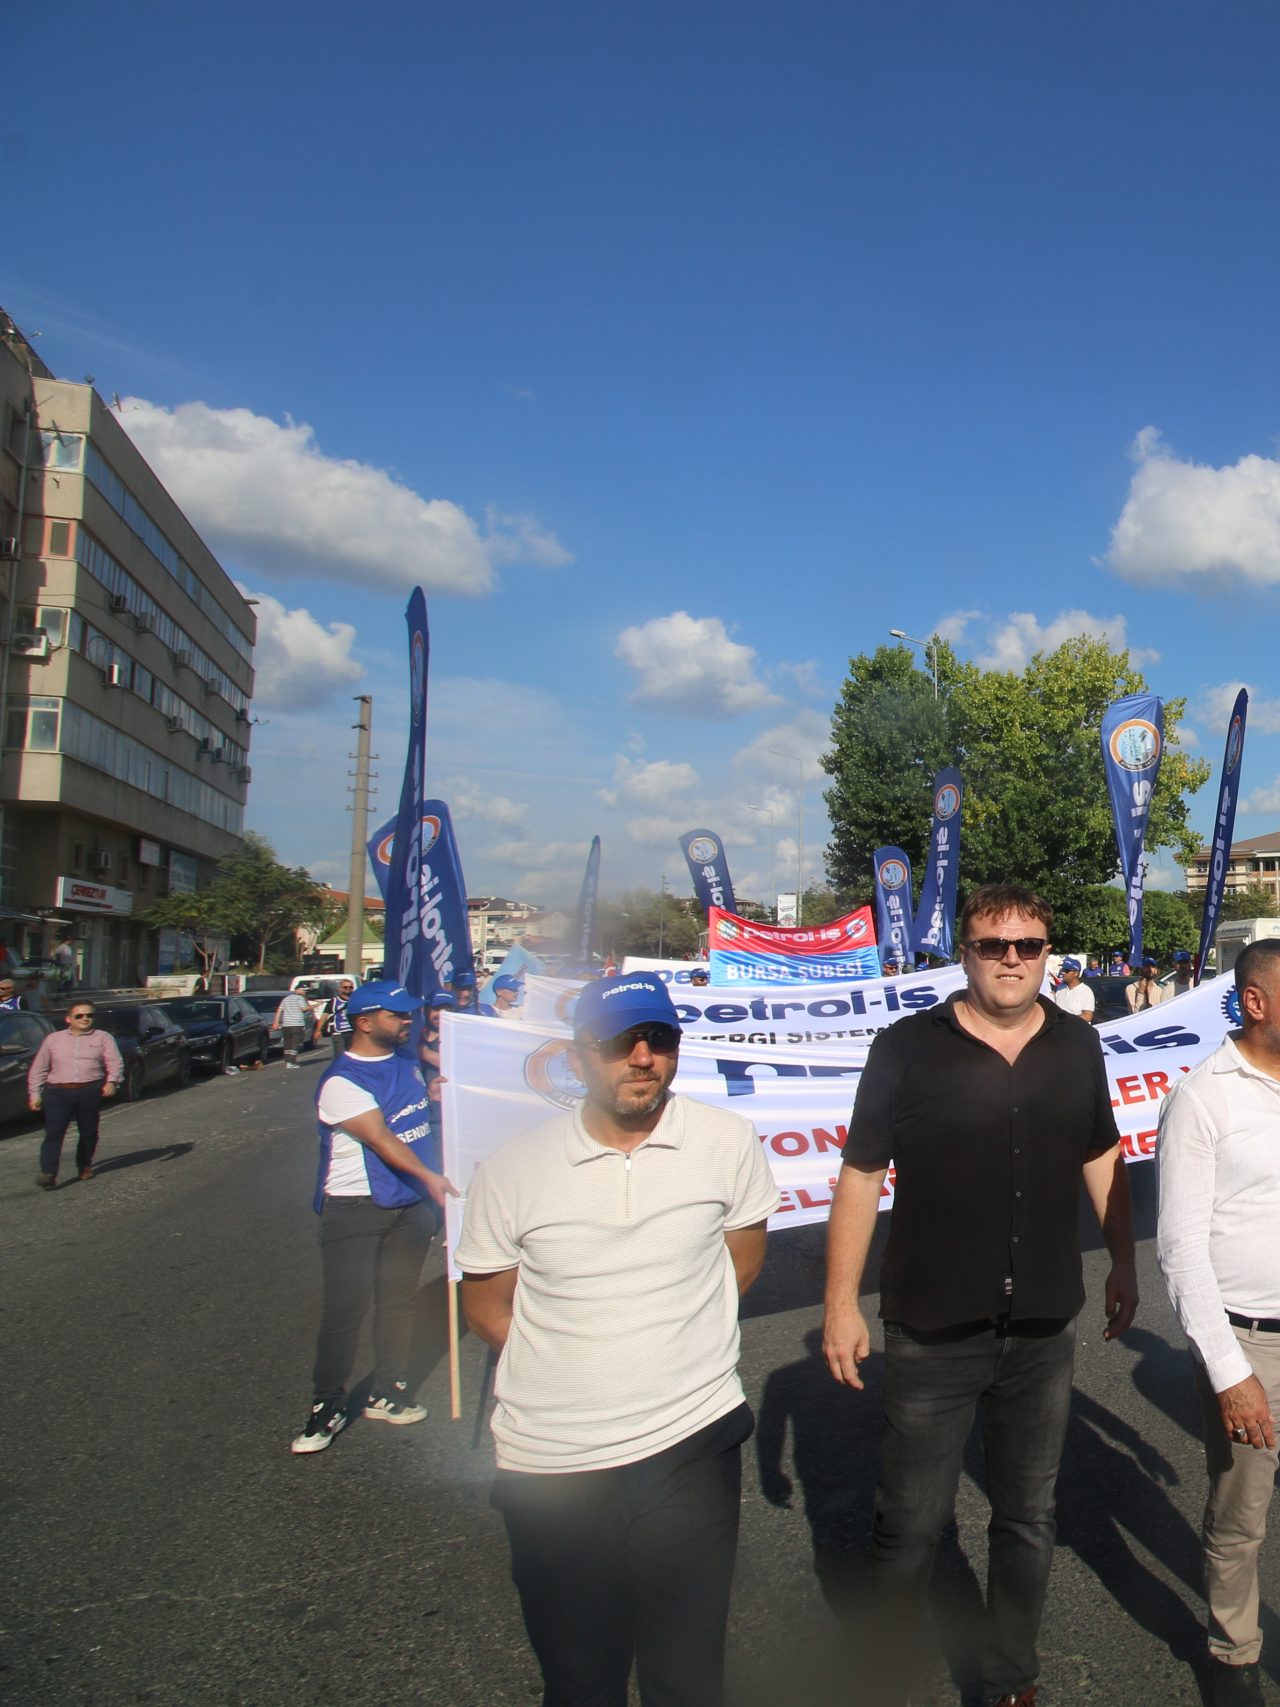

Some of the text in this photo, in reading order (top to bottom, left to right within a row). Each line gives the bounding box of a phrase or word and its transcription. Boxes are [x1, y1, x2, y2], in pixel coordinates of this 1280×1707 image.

[743, 926, 842, 943] petrol-iş
[727, 959, 863, 984] BURSA ŞUBESİ
